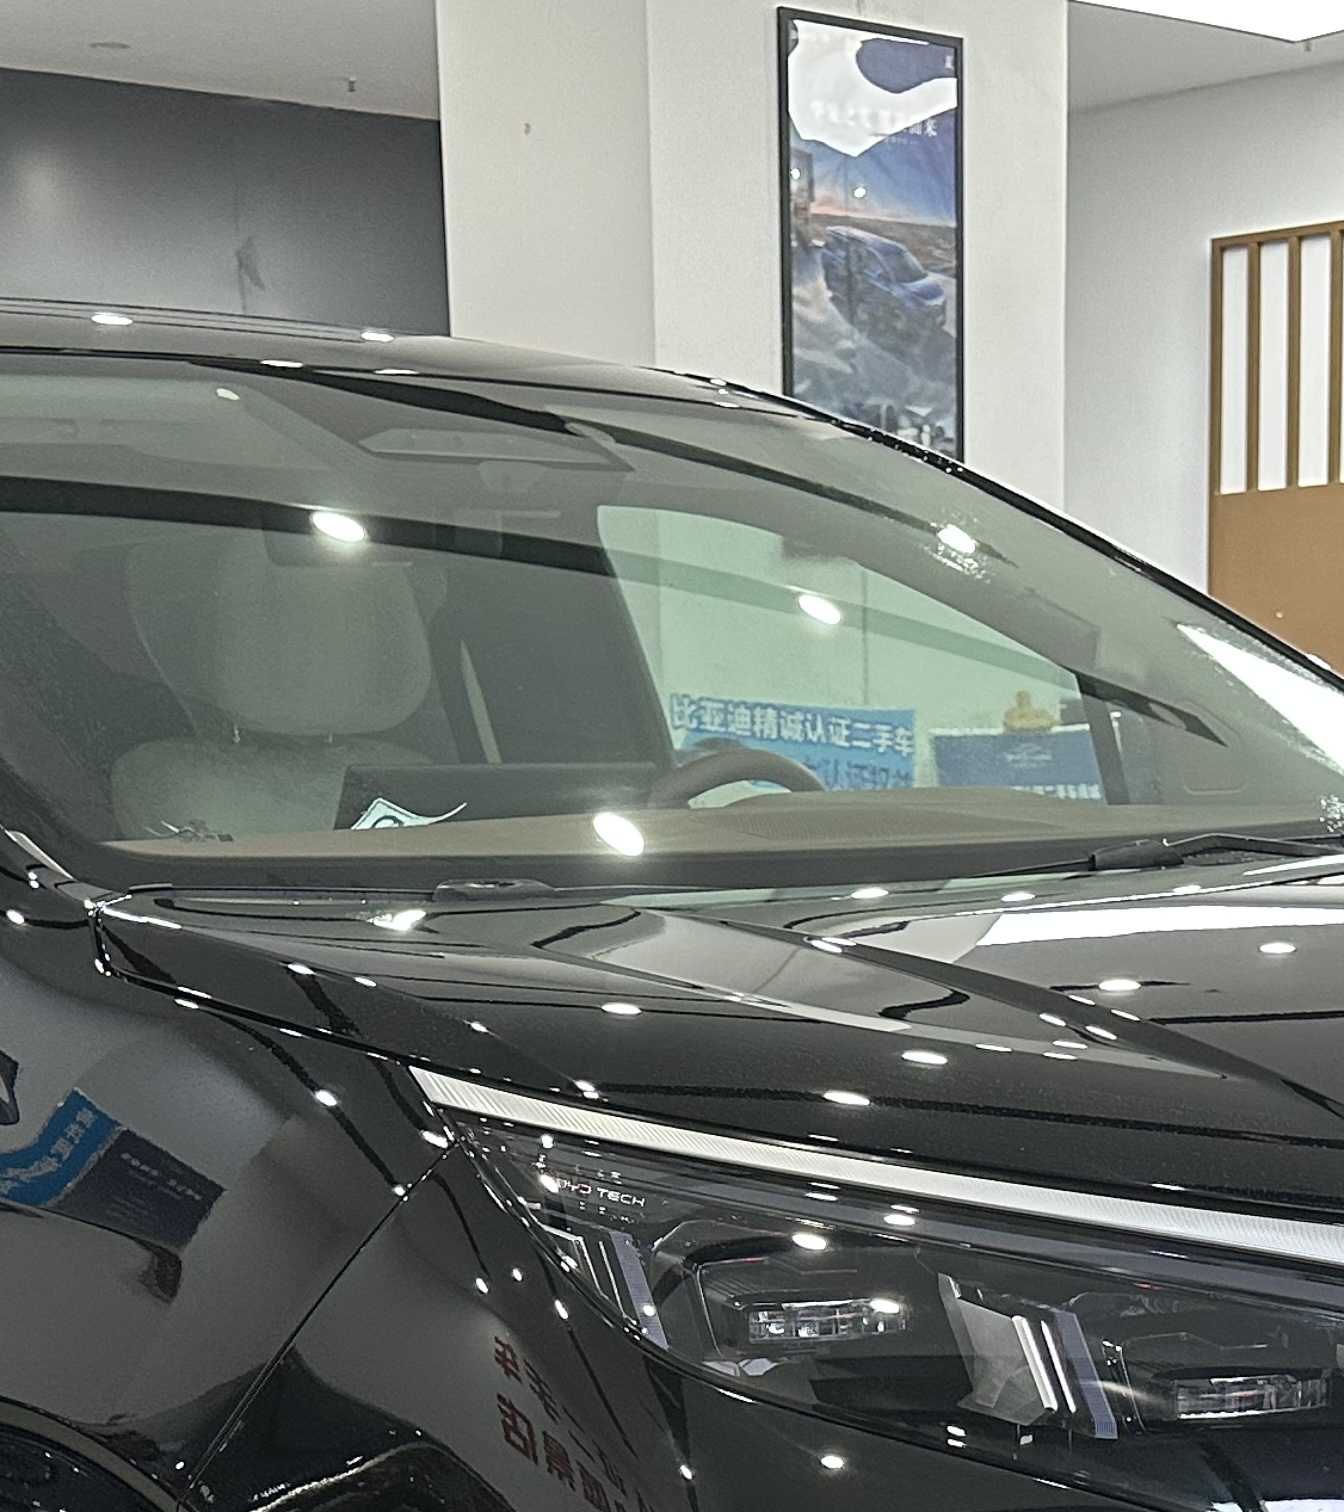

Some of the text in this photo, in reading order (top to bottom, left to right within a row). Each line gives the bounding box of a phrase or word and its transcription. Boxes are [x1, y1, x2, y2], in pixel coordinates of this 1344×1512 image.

[670, 694, 914, 756] 比亚迪精诚认证二手车
[596, 1186, 646, 1207] TECH
